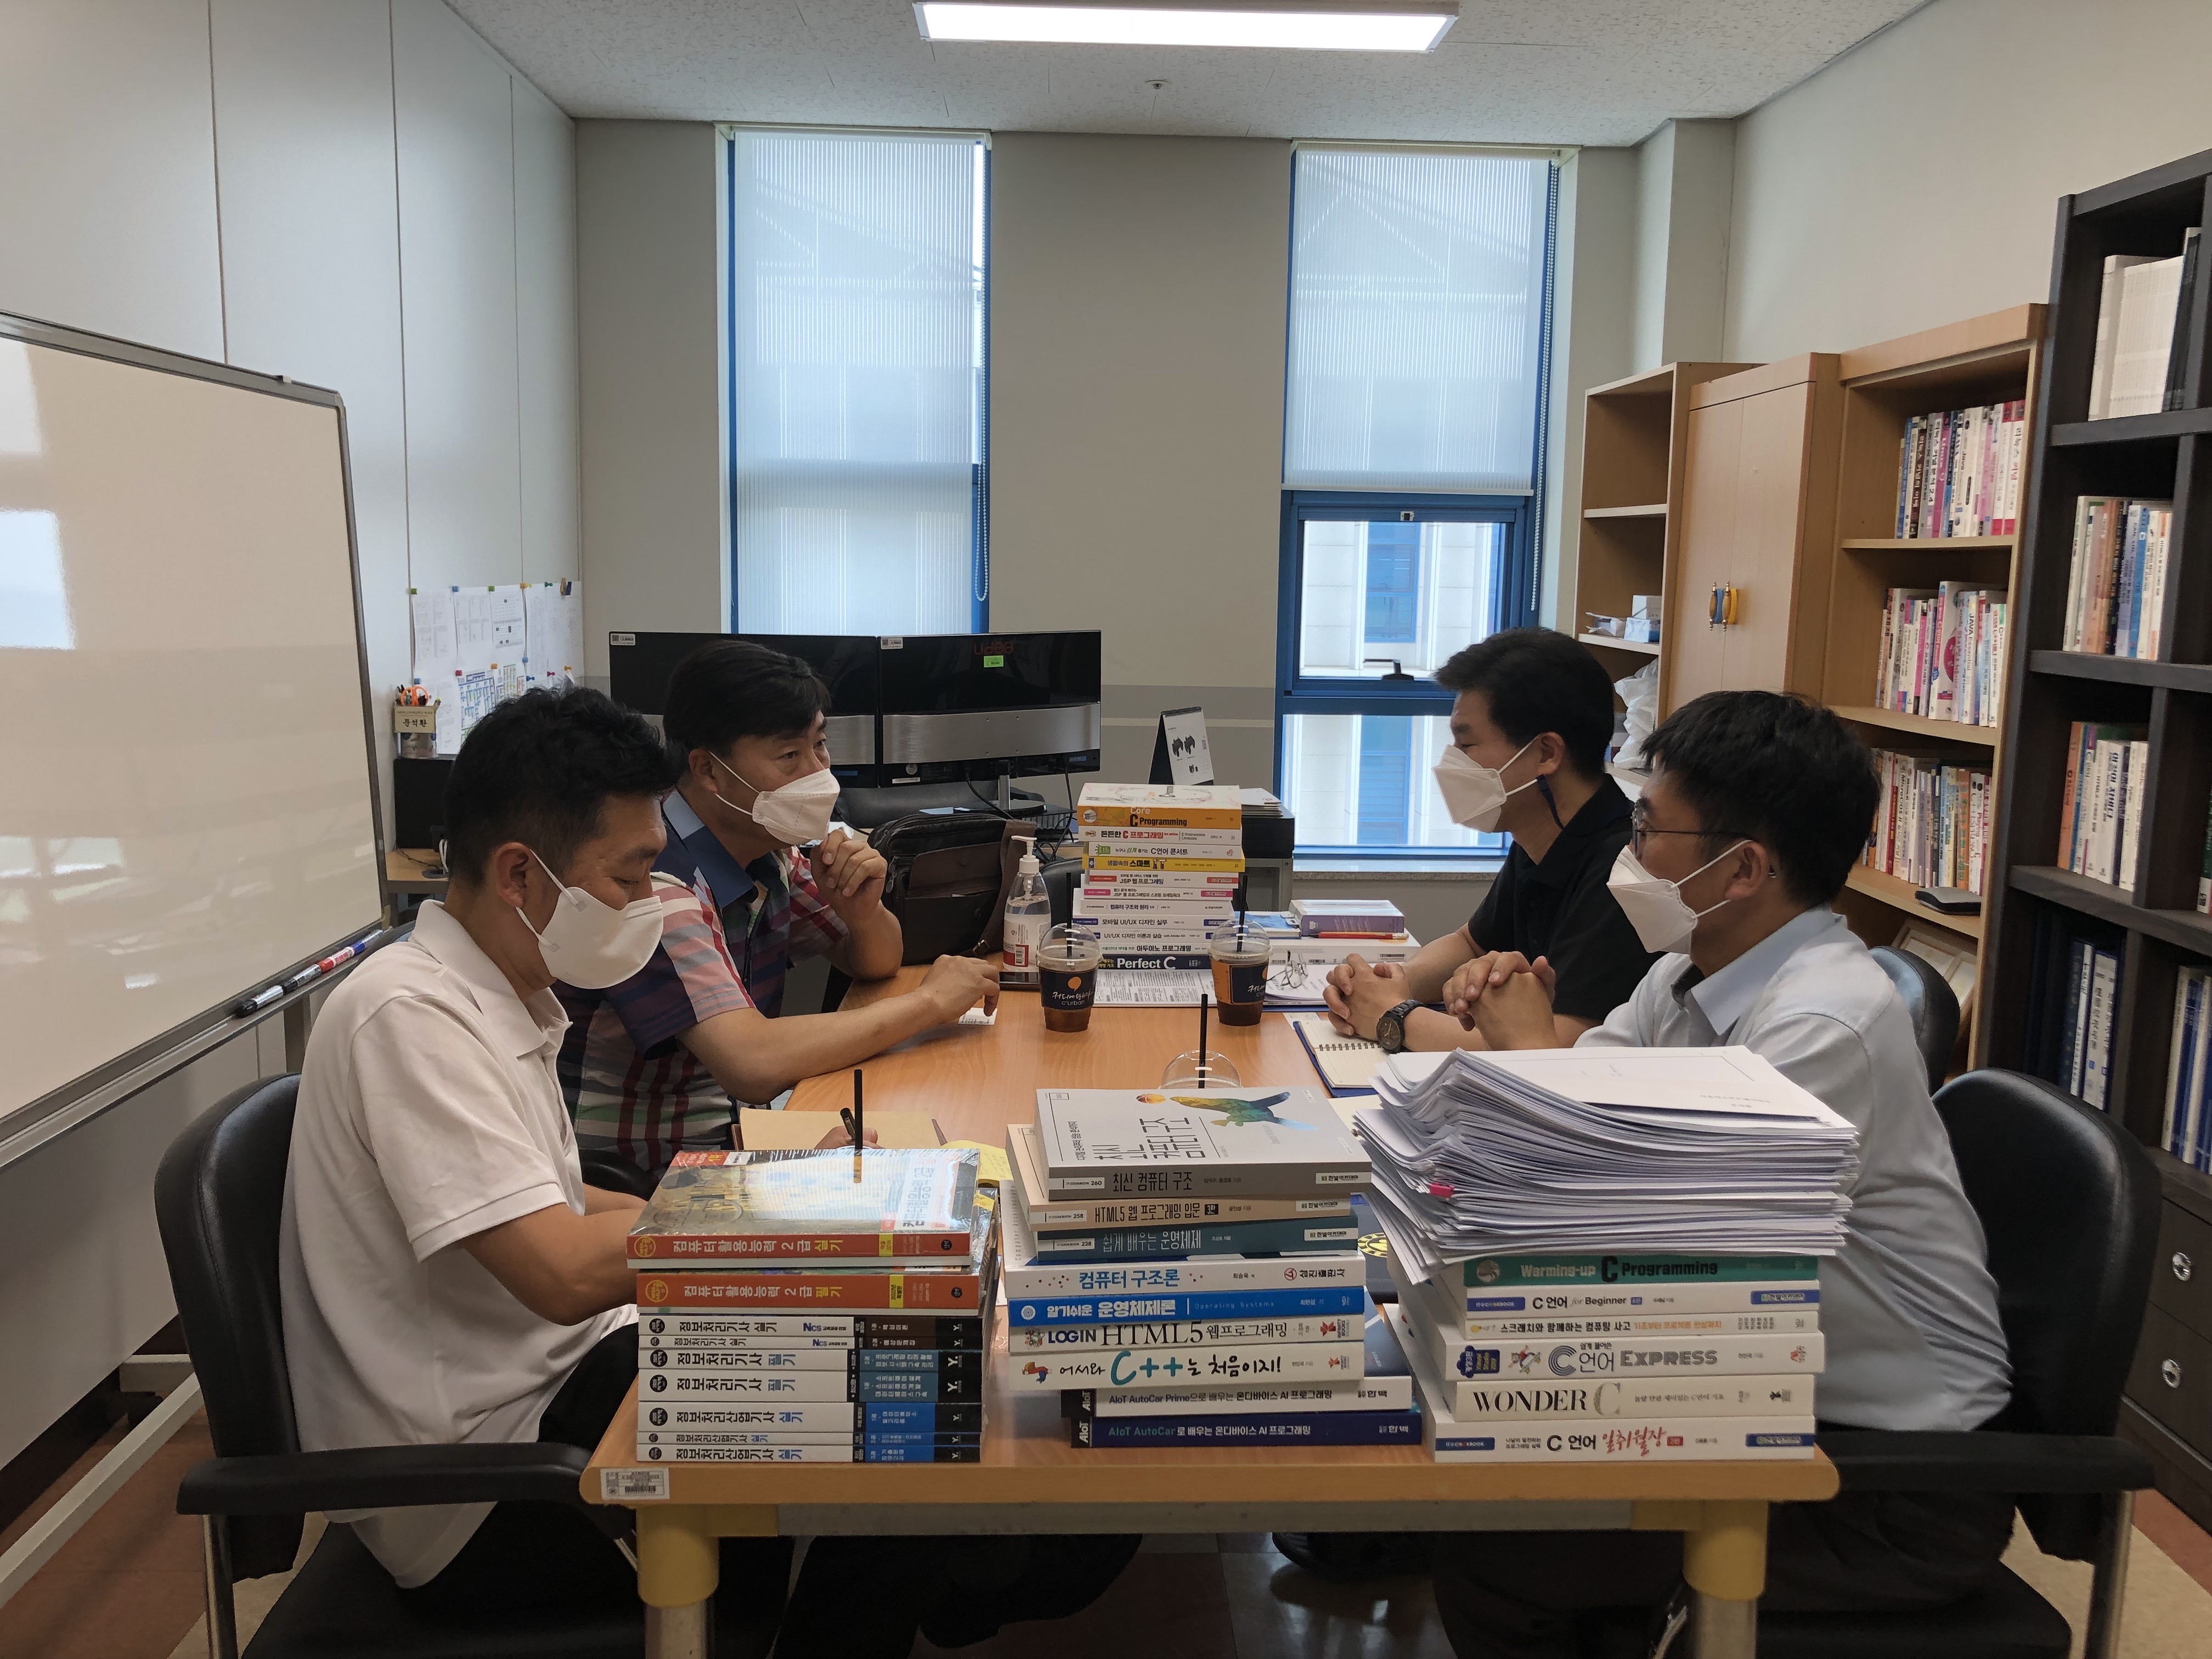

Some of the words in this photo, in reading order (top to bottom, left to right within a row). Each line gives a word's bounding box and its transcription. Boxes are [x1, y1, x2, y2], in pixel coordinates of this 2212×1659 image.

[1130, 814, 1138, 827] C
[1139, 817, 1187, 826] Programming
[1122, 831, 1128, 839] C
[1153, 859, 1166, 869] IT
[1117, 956, 1160, 969] Perfect
[1164, 956, 1176, 969] C
[1113, 1173, 1132, 1192] 최신
[1138, 1172, 1167, 1192] 컴퓨터
[1173, 1172, 1192, 1190] 구조
[1095, 1206, 1125, 1222] HTML5
[1128, 1206, 1137, 1221] 웹
[1141, 1204, 1181, 1220] 프로그래밍
[1184, 1203, 1200, 1218] 입문
[1207, 1205, 1217, 1215] 3판
[673, 1240, 777, 1252] 컴퓨터활용능력
[814, 1240, 843, 1251] 실기
[1103, 1233, 1123, 1252] 쉽게
[1127, 1233, 1156, 1251] 배우는
[1161, 1230, 1201, 1249] 운영체제
[1300, 1269, 1345, 1278] 삼진출판사
[1520, 1264, 1596, 1277] Warming-up
[1601, 1256, 1618, 1283] C
[1622, 1261, 1718, 1277] Programming
[1079, 1271, 1126, 1289] 컴퓨터
[1131, 1268, 1180, 1288] 구조론
[684, 1285, 780, 1297] 컴퓨터활용능력
[816, 1286, 843, 1297] 필기
[1047, 1304, 1092, 1318] 알기쉬운
[1098, 1300, 1176, 1318] 운영체제론
[1533, 1297, 1543, 1310] C
[1546, 1296, 1567, 1308] 언어
[1570, 1299, 1583, 1307] for
[1585, 1297, 1626, 1305] Beginner
[679, 1322, 749, 1333] 정보처리기사
[754, 1322, 777, 1332] 실기
[1048, 1329, 1096, 1344] LOGIN
[1101, 1320, 1203, 1346] HTML5
[1206, 1323, 1287, 1340] 웹프로그래밍
[1500, 1324, 1543, 1333] 스크래치와
[1547, 1322, 1582, 1332] 함께하는
[1586, 1322, 1611, 1331] 컴퓨팅
[1614, 1321, 1630, 1331] 사고
[674, 1338, 726, 1346] 정보처리기사
[730, 1338, 746, 1346] 실기
[678, 1353, 762, 1365] 정보처리기사
[769, 1354, 796, 1365] 필기
[1060, 1363, 1105, 1375] 어서와
[1208, 1354, 1281, 1377] 처음이지!
[677, 1378, 762, 1391] 정보처리기사
[768, 1379, 795, 1391] 필기
[1082, 1391, 1091, 1411] AIoT
[1109, 1395, 1127, 1403] AIoT
[1129, 1395, 1163, 1403] AutoCar
[1209, 1392, 1233, 1402] 배우는
[1236, 1391, 1278, 1401] 온디바이스
[1290, 1390, 1332, 1400] 프로그래밍
[1472, 1390, 1587, 1412] WONDER
[1593, 1382, 1621, 1416] C
[676, 1412, 775, 1423] 정보처리산업기사
[779, 1412, 803, 1423] 실기
[1079, 1421, 1088, 1443] AIoT
[1109, 1427, 1131, 1436] AIoT
[1134, 1427, 1175, 1436] AutoCar
[1187, 1426, 1212, 1436] 배우는
[1215, 1426, 1256, 1436] 온디바이스
[1259, 1427, 1267, 1435] AI
[1269, 1426, 1311, 1436] 프로그래밍
[676, 1434, 747, 1442] 정보처리산업기사
[1547, 1435, 1562, 1452] C
[1568, 1435, 1596, 1450] 언어
[1602, 1426, 1667, 1457] 일취월장
[676, 1448, 774, 1460] 정보처리산업기사
[778, 1449, 802, 1460] 실기
